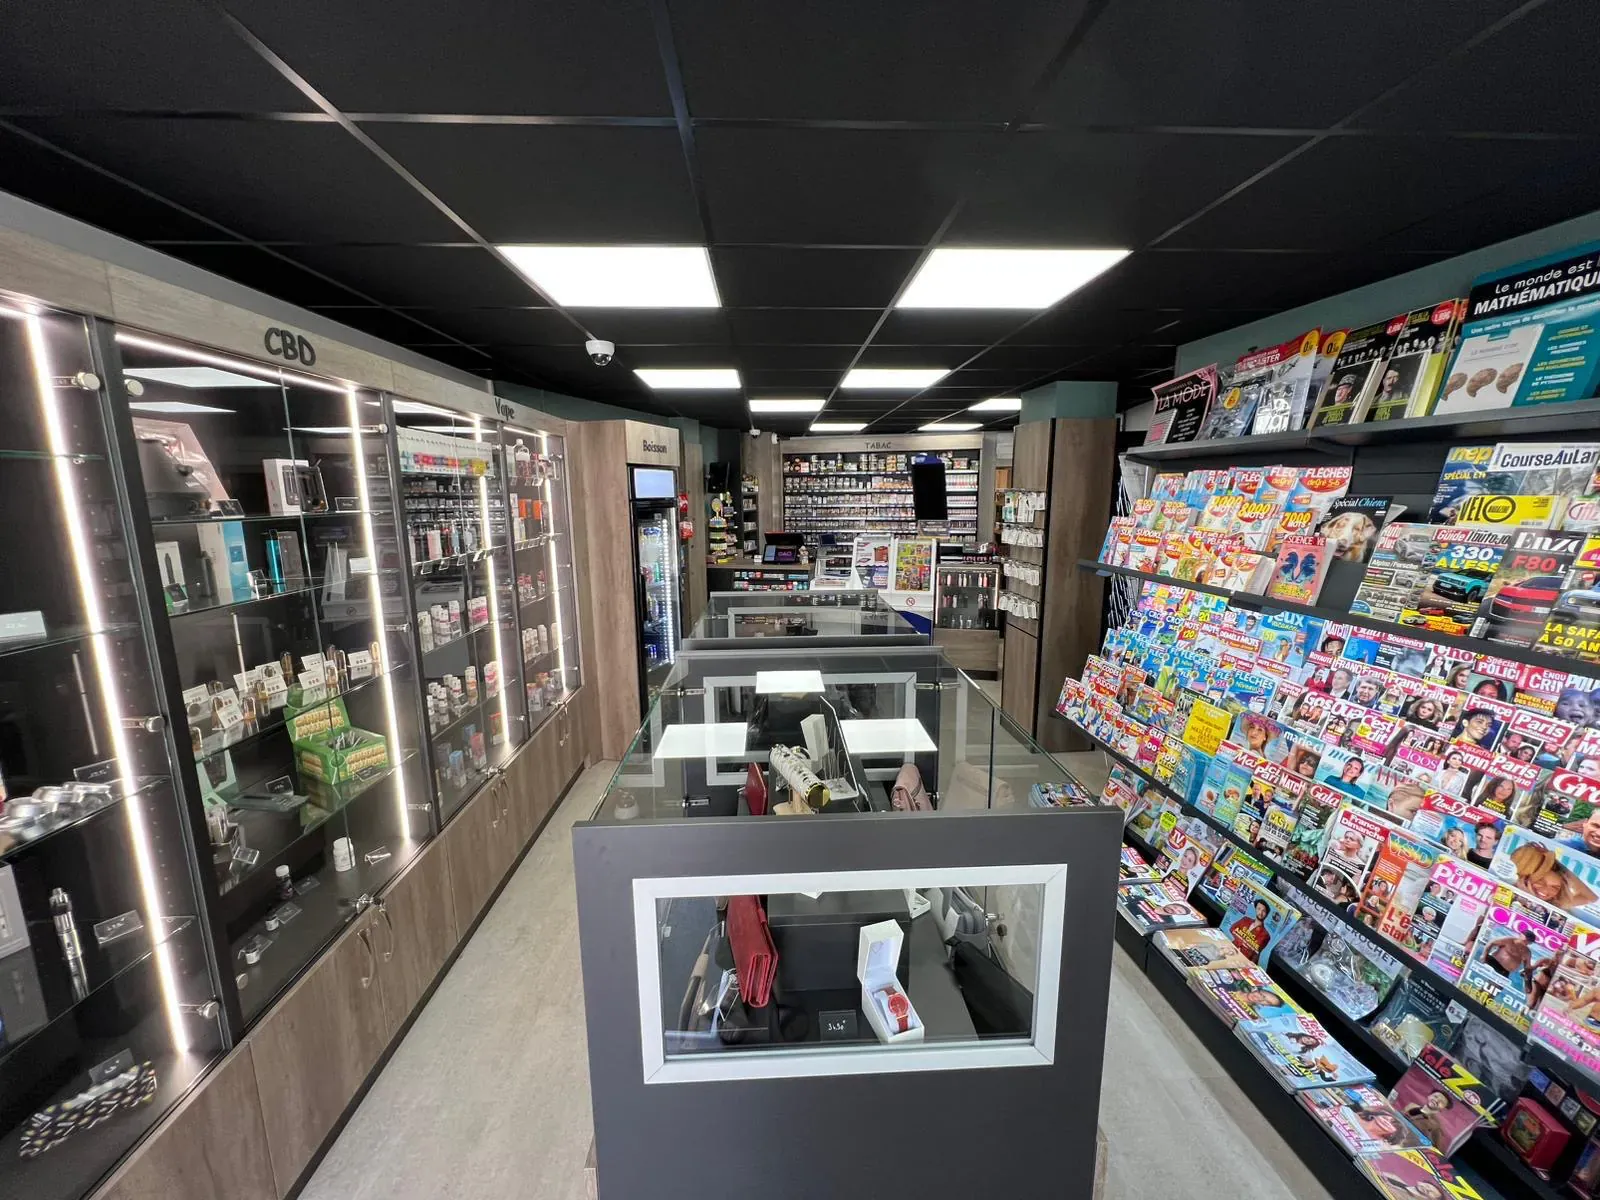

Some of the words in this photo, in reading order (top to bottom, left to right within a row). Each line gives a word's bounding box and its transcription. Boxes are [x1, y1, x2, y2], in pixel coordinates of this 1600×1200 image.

[1496, 284, 1509, 294] Le
[1514, 269, 1562, 289] monde
[1568, 259, 1593, 275] est
[264, 327, 316, 366] CBD
[1172, 381, 1207, 408] MODE
[495, 398, 515, 420] Vape
[643, 440, 667, 454] Boisson
[1240, 503, 1271, 517] 8000
[1334, 498, 1359, 509] Spécial
[1359, 496, 1388, 508] Chiens
[1283, 512, 1311, 525] 7000
[1288, 537, 1313, 545] SCIENCE
[1451, 545, 1494, 561] 330
[1511, 555, 1557, 573] F80
[1544, 622, 1563, 634] LA
[1387, 633, 1424, 648] Souvenirs
[1538, 631, 1550, 643] À
[1554, 636, 1575, 649] 50
[1487, 655, 1519, 668] Spécial
[1470, 694, 1514, 719] France
[1514, 713, 1567, 738] Paris
[1309, 783, 1342, 809] Gala
[1341, 818, 1386, 843] Dimanche
[1350, 813, 1382, 832] France
[1344, 922, 1398, 968] CROCHET
[1465, 969, 1502, 997] Leur
